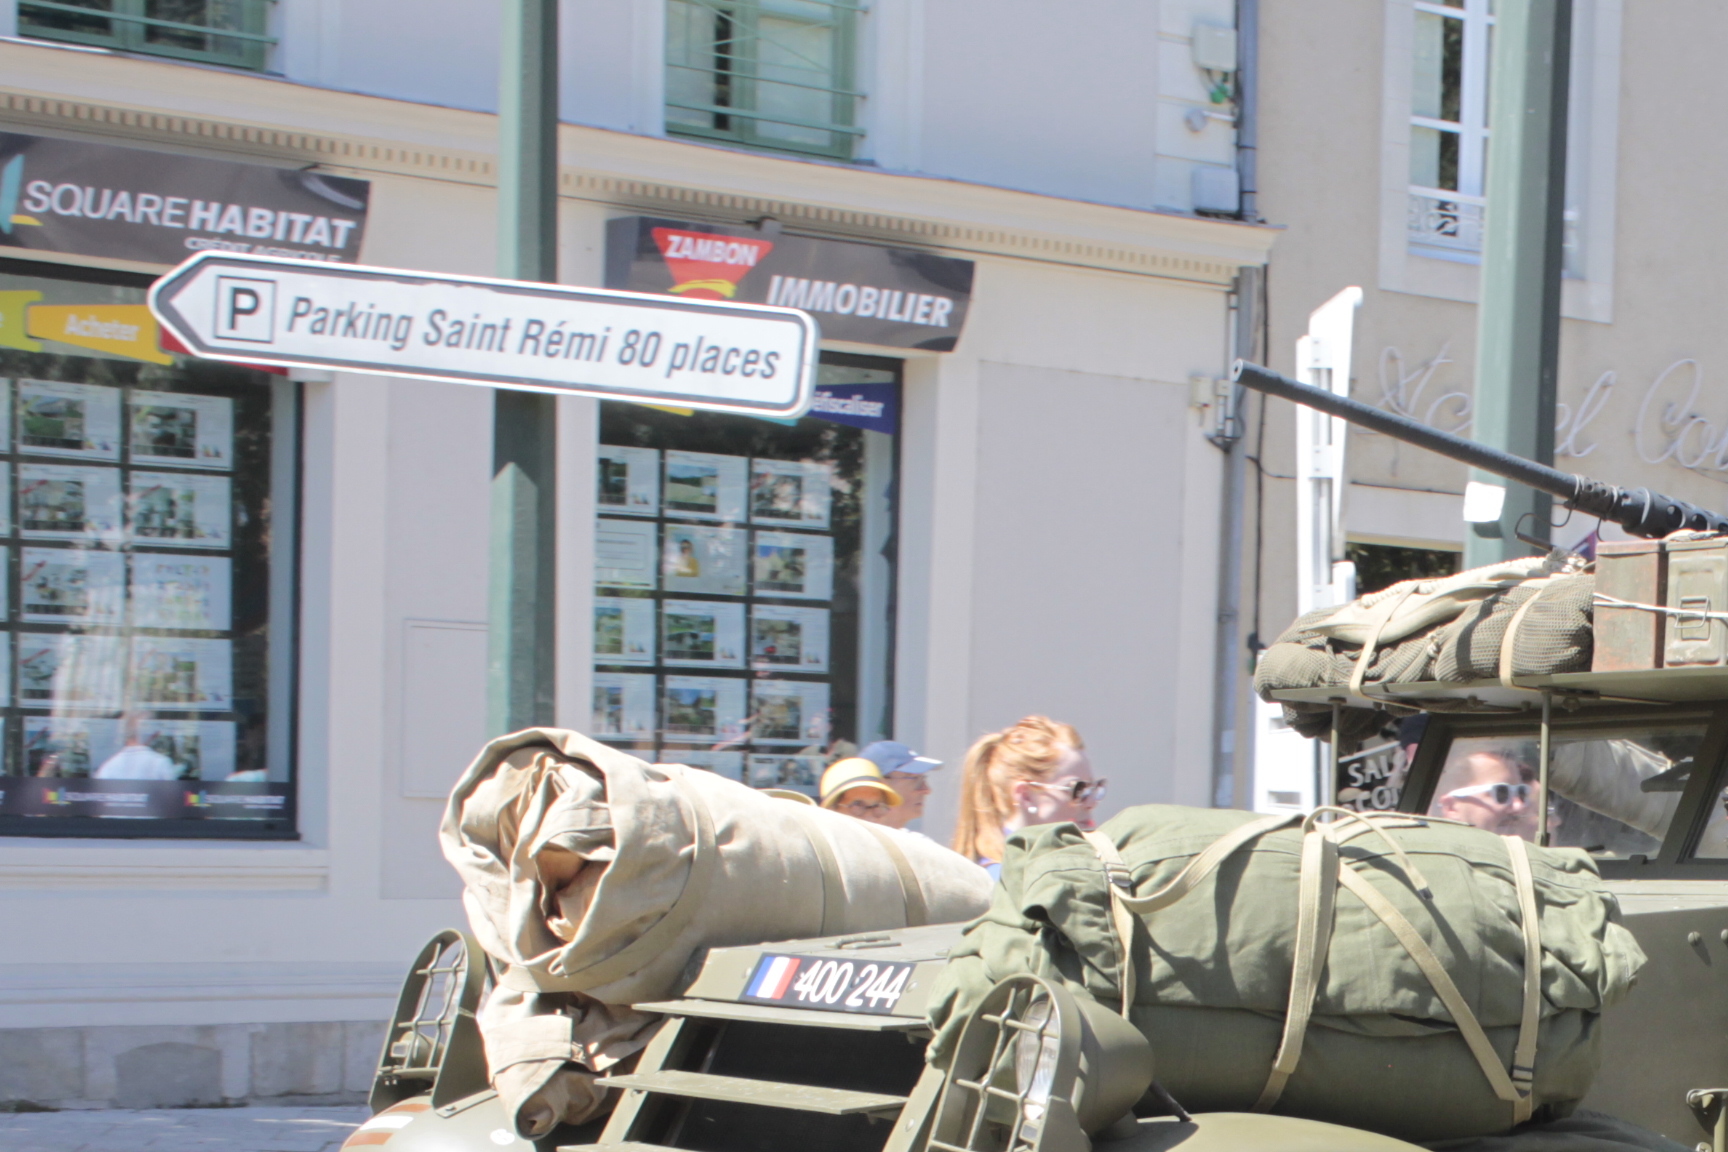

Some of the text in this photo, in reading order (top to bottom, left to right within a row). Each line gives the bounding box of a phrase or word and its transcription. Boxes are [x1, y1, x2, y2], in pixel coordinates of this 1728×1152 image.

[664, 235, 760, 266] ZAMBON
[229, 286, 260, 330] P
[766, 275, 954, 327] IMMOBILIER
[64, 313, 140, 342] Acheter
[287, 297, 780, 378] Parking Saint Rémi 80 places
[813, 391, 884, 417] éfiscaliser
[794, 960, 911, 1008] 400 244
